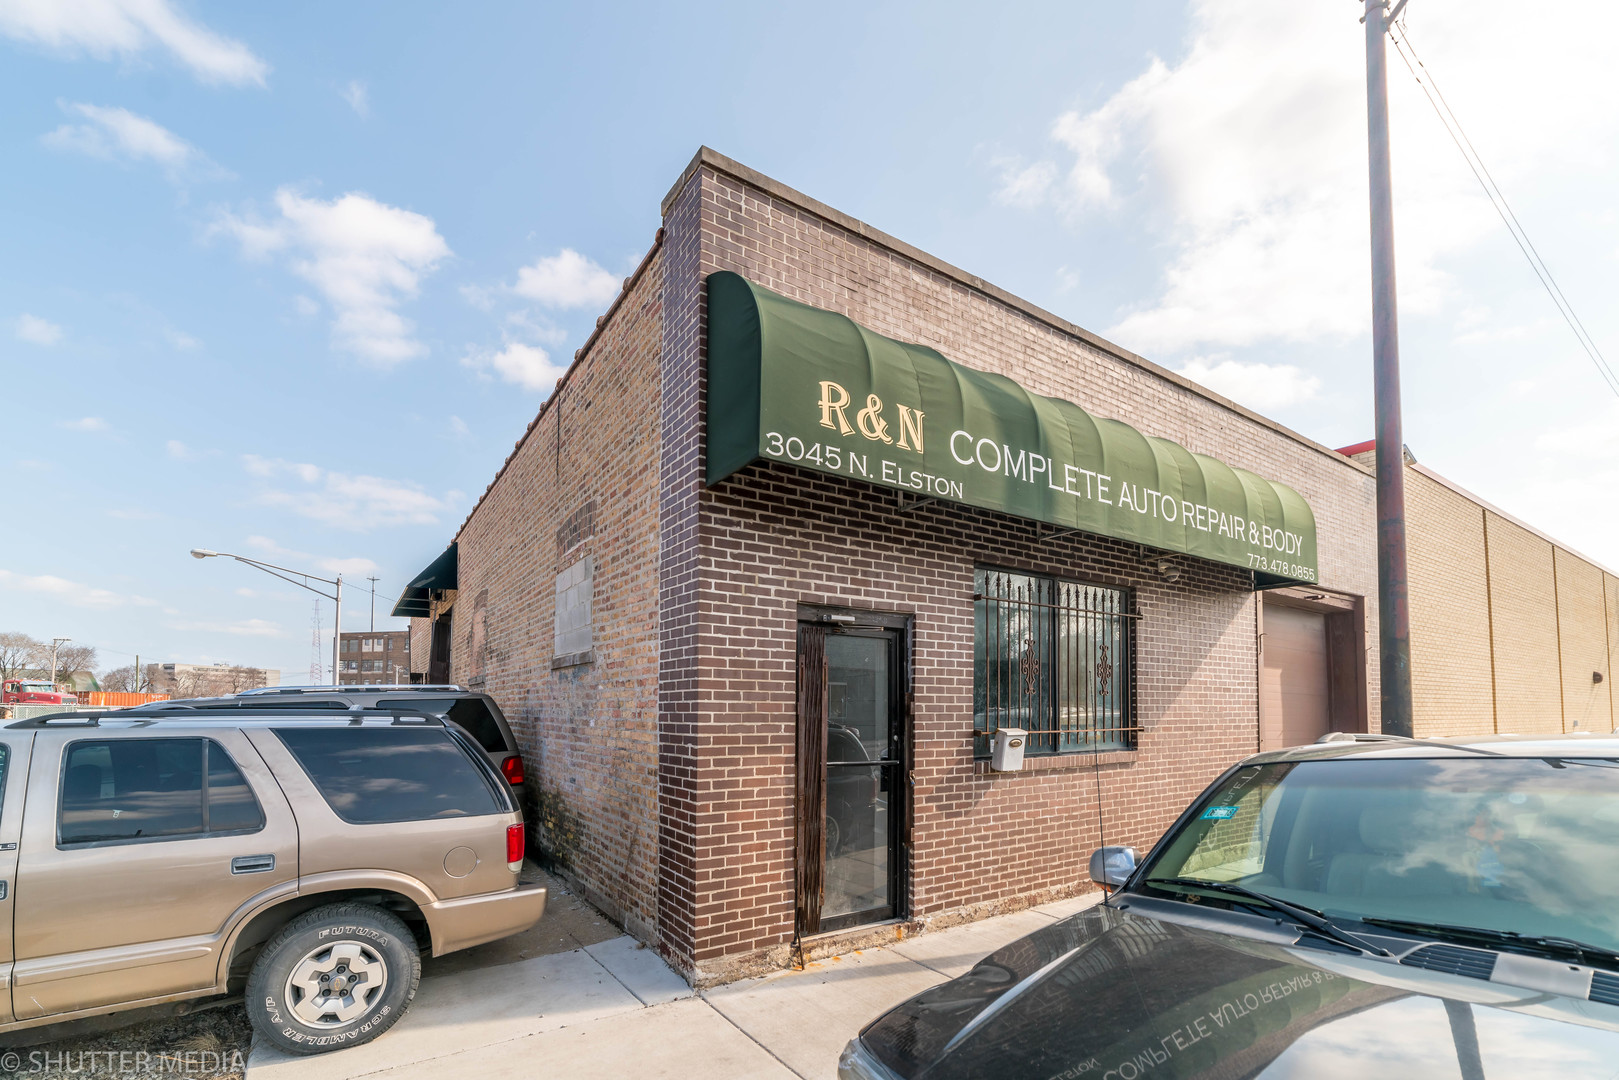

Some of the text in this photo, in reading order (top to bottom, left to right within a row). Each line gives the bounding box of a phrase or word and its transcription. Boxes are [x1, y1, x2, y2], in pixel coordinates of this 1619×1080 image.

[817, 380, 926, 455] R&N
[765, 431, 963, 499] 3045 N. ELSTON
[949, 430, 1303, 557] COMPLETE AUTO REPAIR & BODY
[1247, 553, 1315, 581] 773.478.0855
[318, 926, 388, 947] FUTURA
[265, 996, 391, 1046] SCRAMBLER A/P
